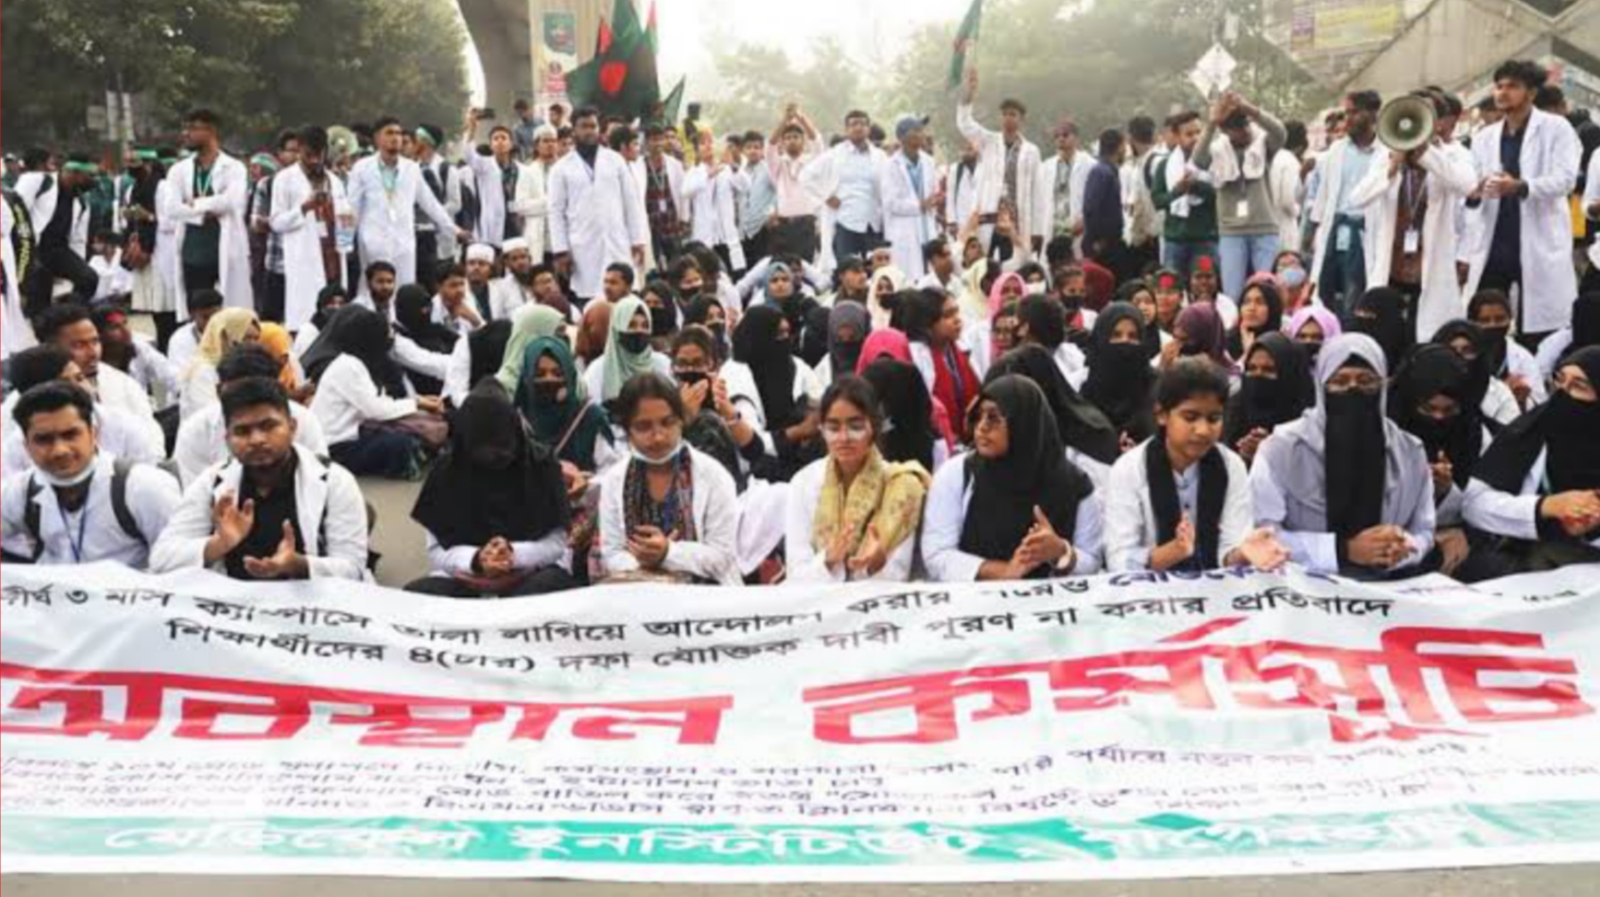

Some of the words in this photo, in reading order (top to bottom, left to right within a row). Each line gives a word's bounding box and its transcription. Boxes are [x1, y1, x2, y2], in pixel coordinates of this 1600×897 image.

[66, 588, 88, 604] ৩
[105, 588, 174, 607] মাস
[498, 620, 627, 643] লাগিয়ে
[847, 590, 950, 614] করার
[556, 651, 632, 671] দফা
[653, 636, 801, 667] যৌক্তিক
[820, 621, 901, 650] দাবী
[1033, 606, 1078, 626] না
[1095, 597, 1208, 618] করার
[1231, 586, 1395, 616] প্রতিবাদে
